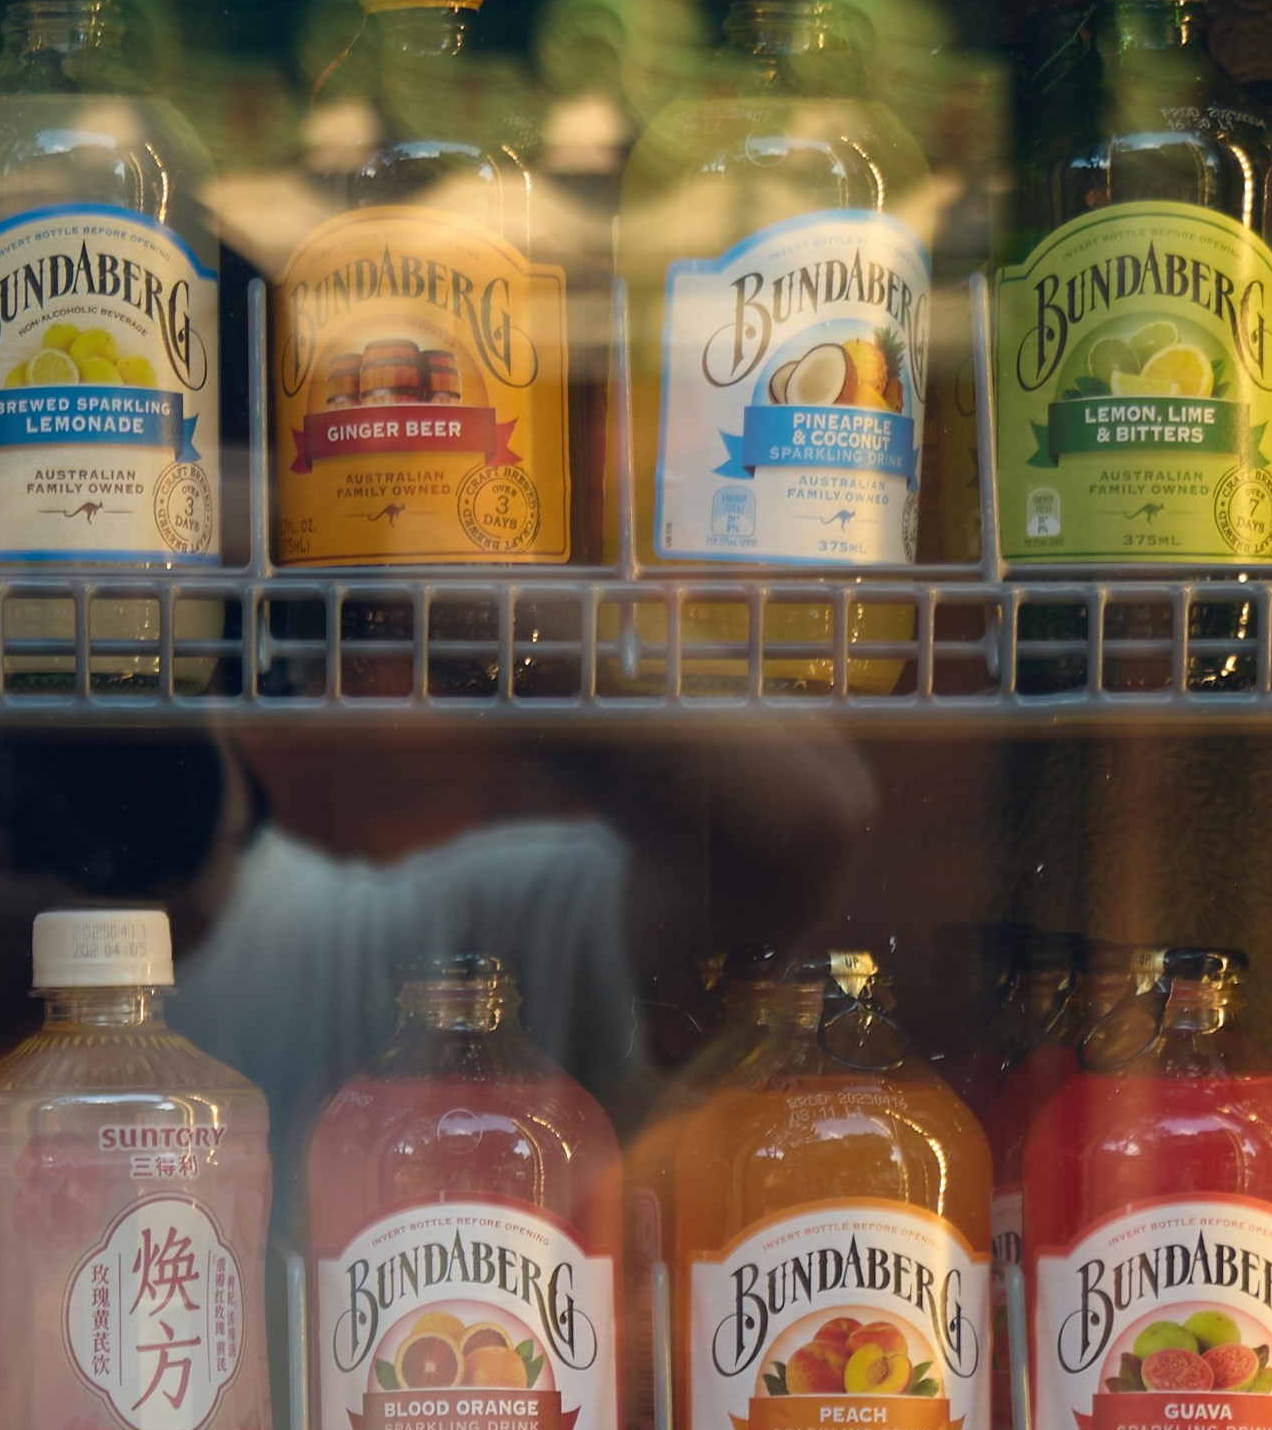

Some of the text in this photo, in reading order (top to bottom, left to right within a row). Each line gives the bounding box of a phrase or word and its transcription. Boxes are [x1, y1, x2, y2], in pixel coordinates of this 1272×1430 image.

[280, 242, 539, 399] BUNDABERG
[77, 397, 171, 416] SPARKLING
[1084, 406, 1217, 425] LEMON, LIME
[25, 416, 145, 435] LEMONADE
[326, 421, 462, 443] GINGER BEER
[792, 412, 892, 437] PINEAPPLE
[810, 431, 891, 451] COCONUT
[1115, 426, 1205, 444] BITTERS
[34, 469, 137, 482] AUSTRALIAN
[26, 482, 145, 495] FAMILY OWNED
[100, 1126, 227, 1150] SUNTORY
[371, 1216, 551, 1250] INVERT BOTTLE BEFORE OPENING
[333, 1227, 598, 1373] BUNDABERG
[712, 1233, 980, 1379] BUNDABERG
[90, 1262, 112, 1378] 玫瑰黄芪饮
[128, 1226, 203, 1413] 焕方
[384, 1399, 540, 1419] BLOOD ORANGE
[819, 1407, 888, 1424] PEACH
[1164, 1403, 1234, 1421] GUAVA
